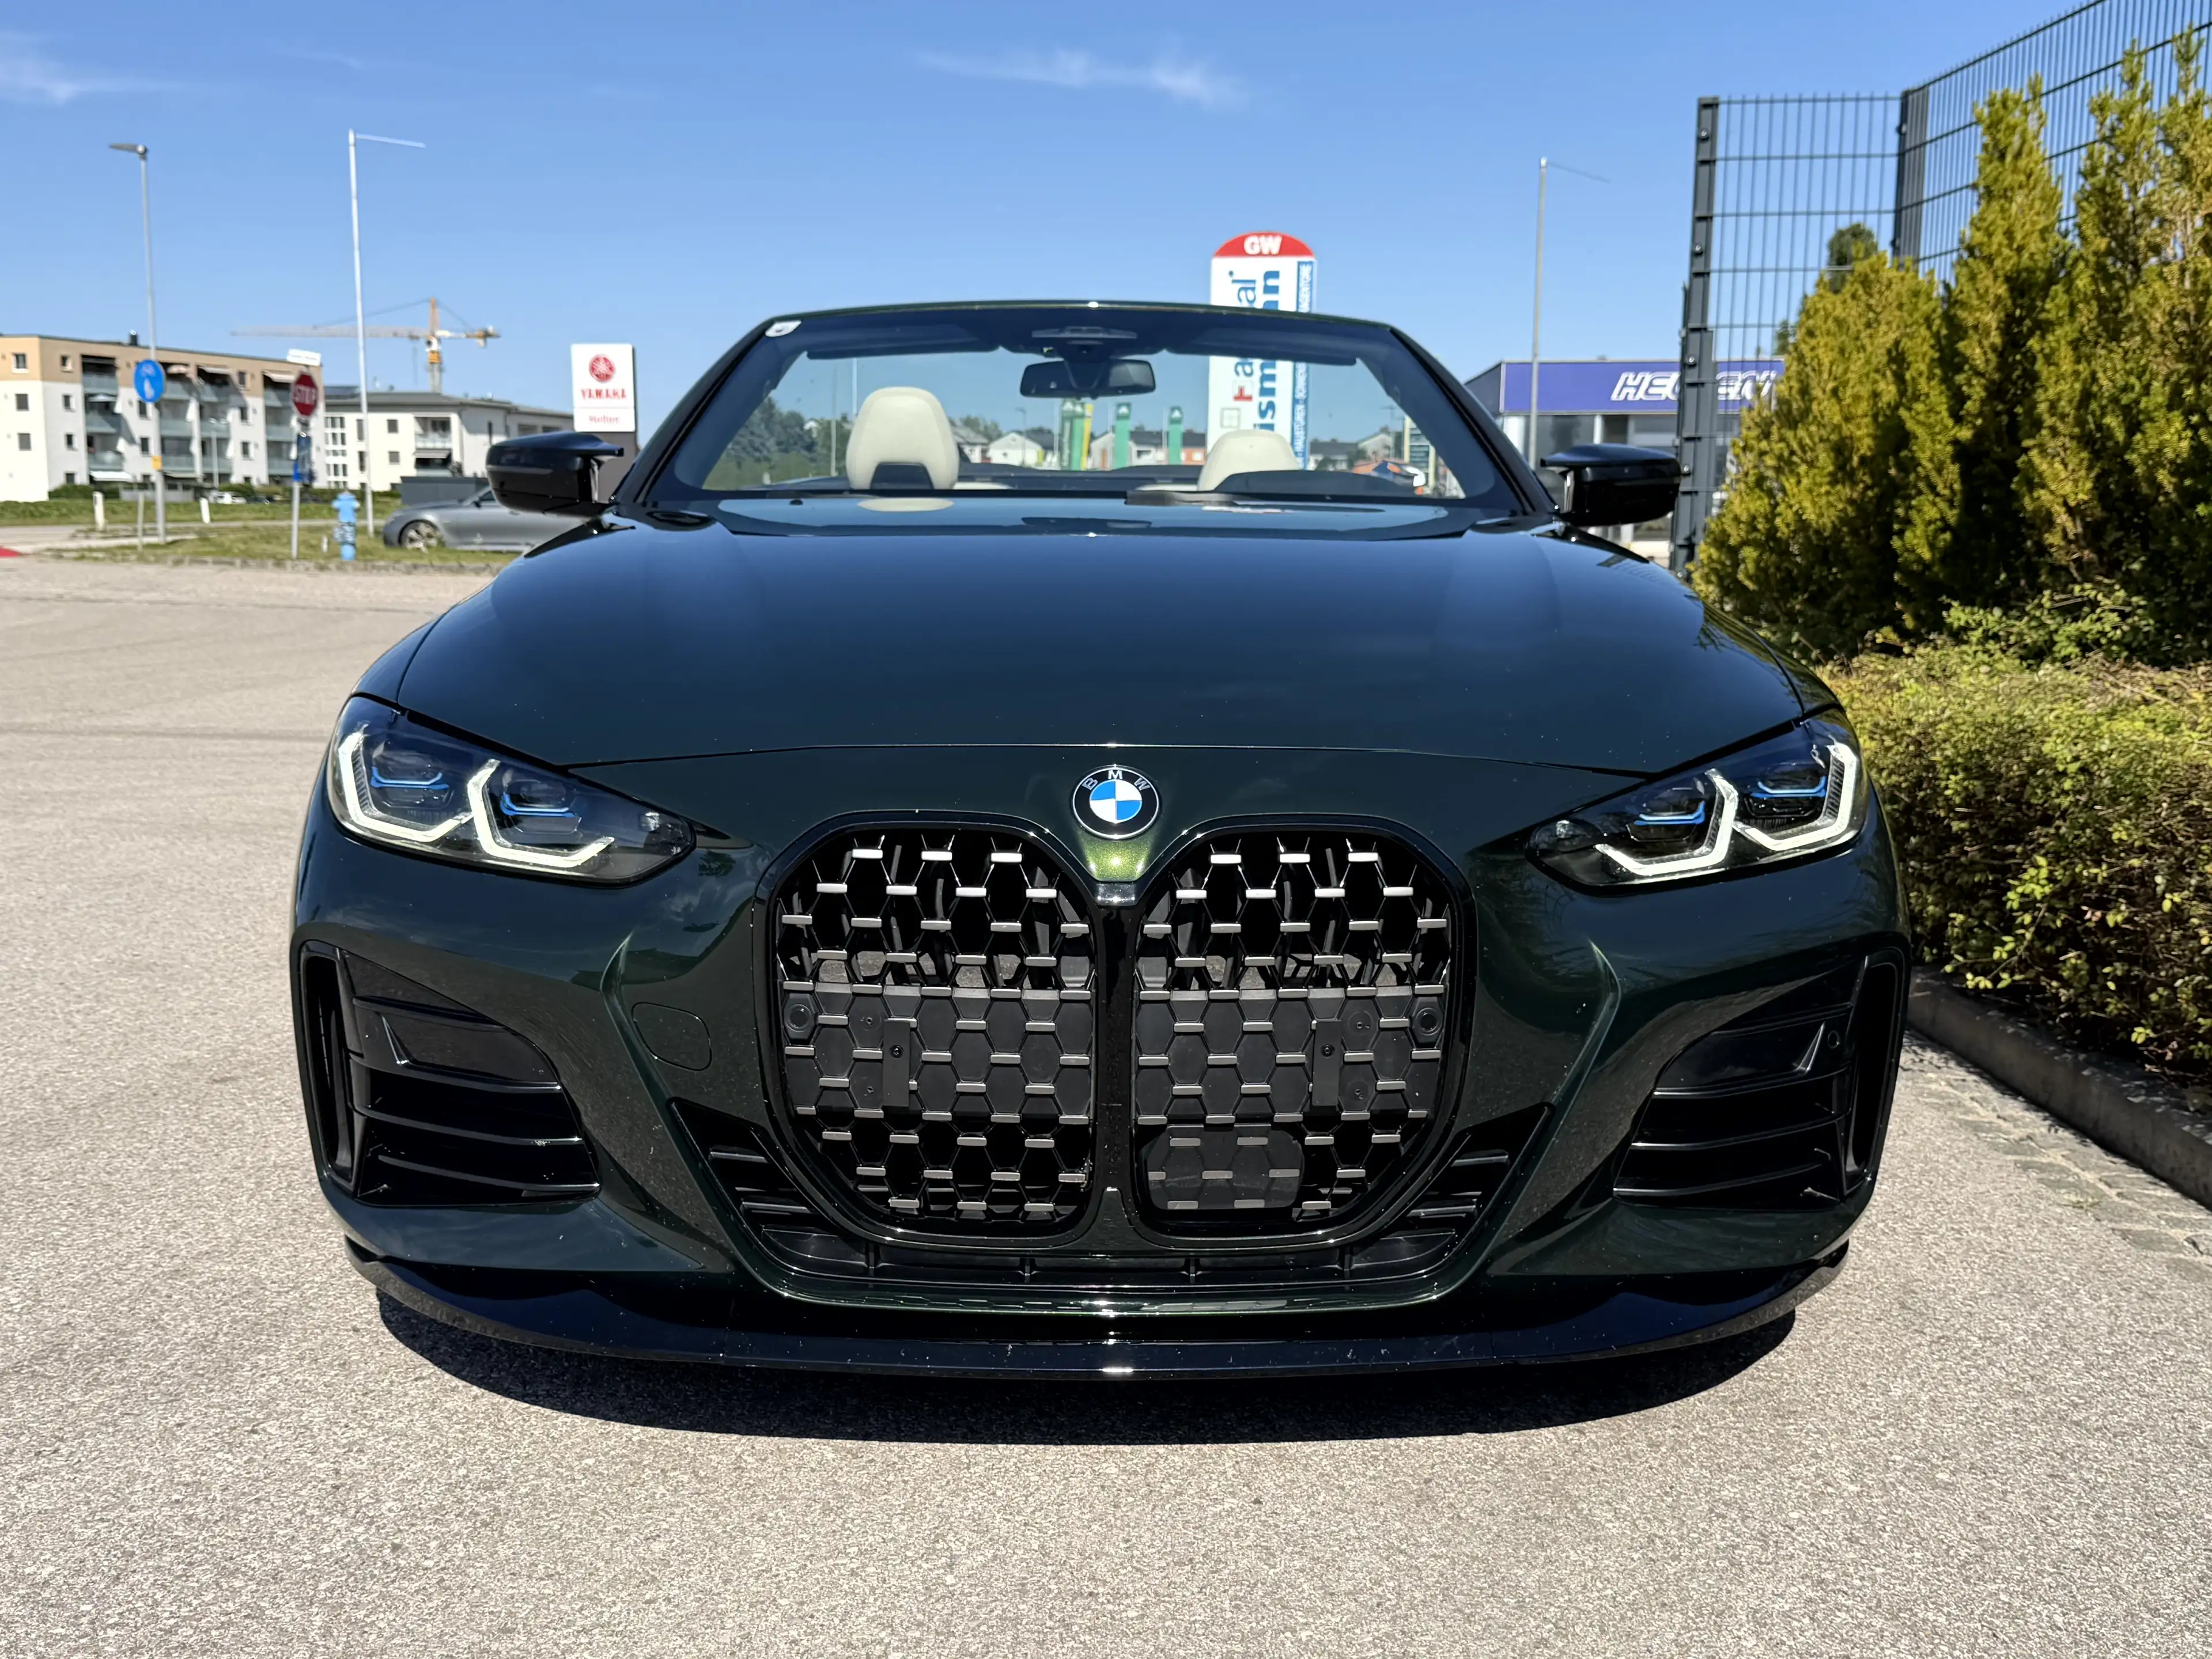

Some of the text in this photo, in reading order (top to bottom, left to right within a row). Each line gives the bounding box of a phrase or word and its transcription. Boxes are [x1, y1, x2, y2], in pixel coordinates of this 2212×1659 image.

[1243, 235, 1283, 255] GW
[580, 388, 626, 400] YAMAHA
[1082, 770, 1151, 791] BMW
